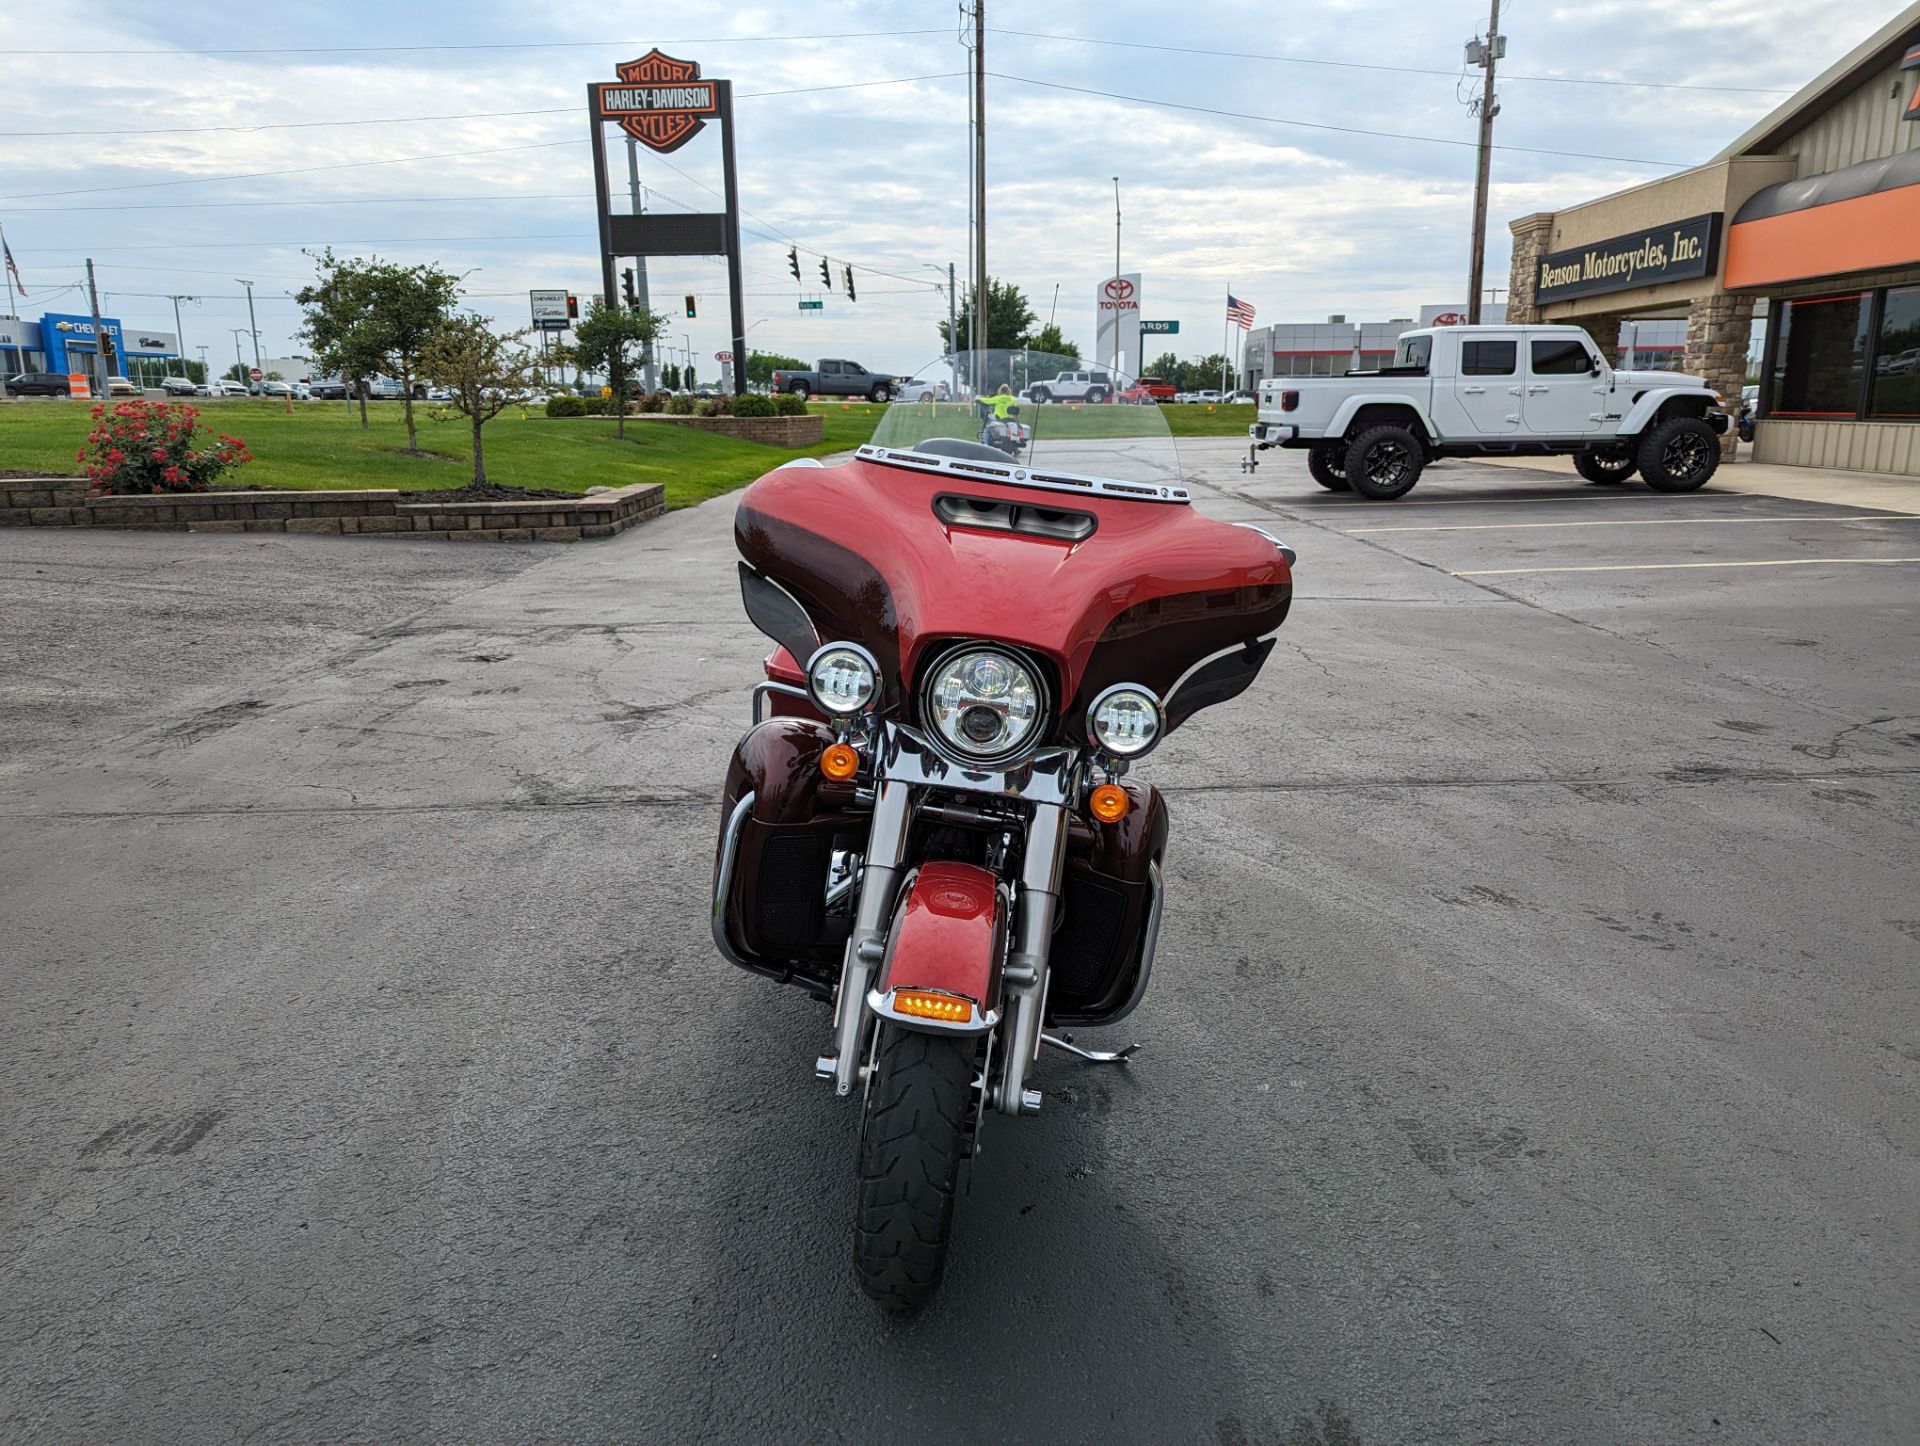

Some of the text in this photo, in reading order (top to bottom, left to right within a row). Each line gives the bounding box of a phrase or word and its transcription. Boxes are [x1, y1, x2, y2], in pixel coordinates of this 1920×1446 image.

[628, 59, 684, 81] MOTOR
[605, 87, 710, 110] HARLEY-DAVIDSON
[631, 114, 686, 140] CYCLES
[1540, 231, 1702, 288] Benson Motorcycles, Inc.
[1099, 301, 1138, 310] TOYOTA
[74, 323, 118, 336] CHEVOLET
